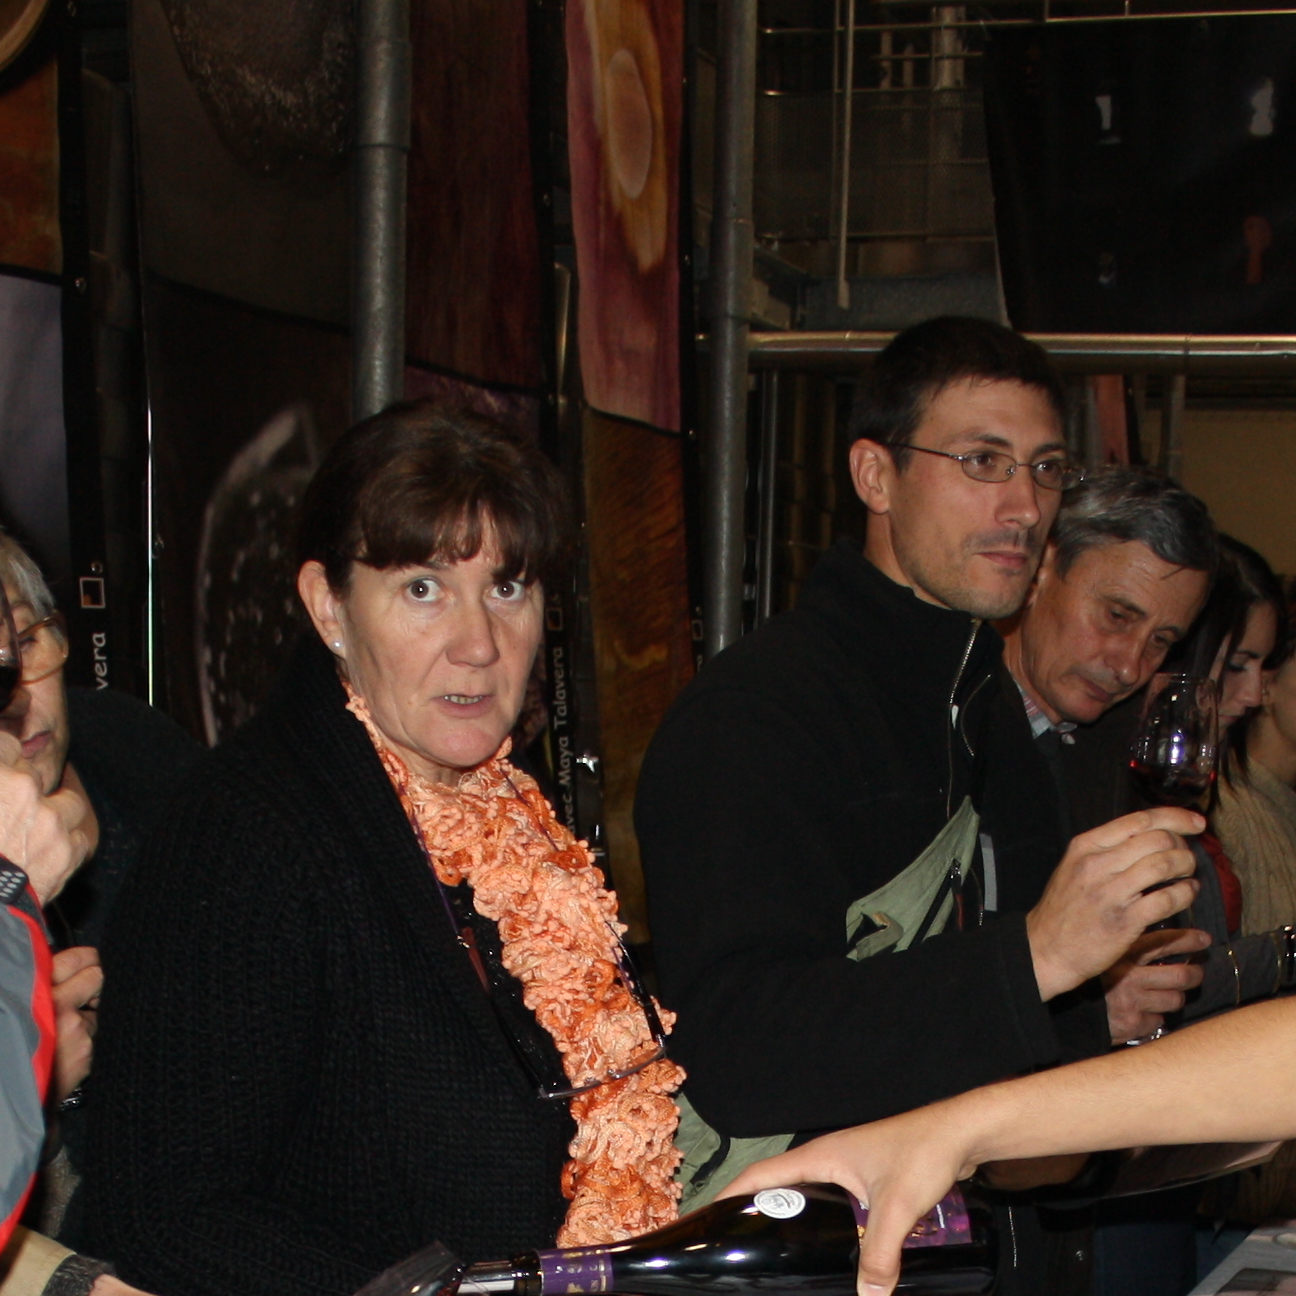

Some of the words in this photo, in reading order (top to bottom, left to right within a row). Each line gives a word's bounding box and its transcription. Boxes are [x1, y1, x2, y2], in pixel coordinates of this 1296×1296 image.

[93, 632, 107, 691] vera
[553, 646, 567, 730] Talavera
[558, 736, 574, 786] Maya
